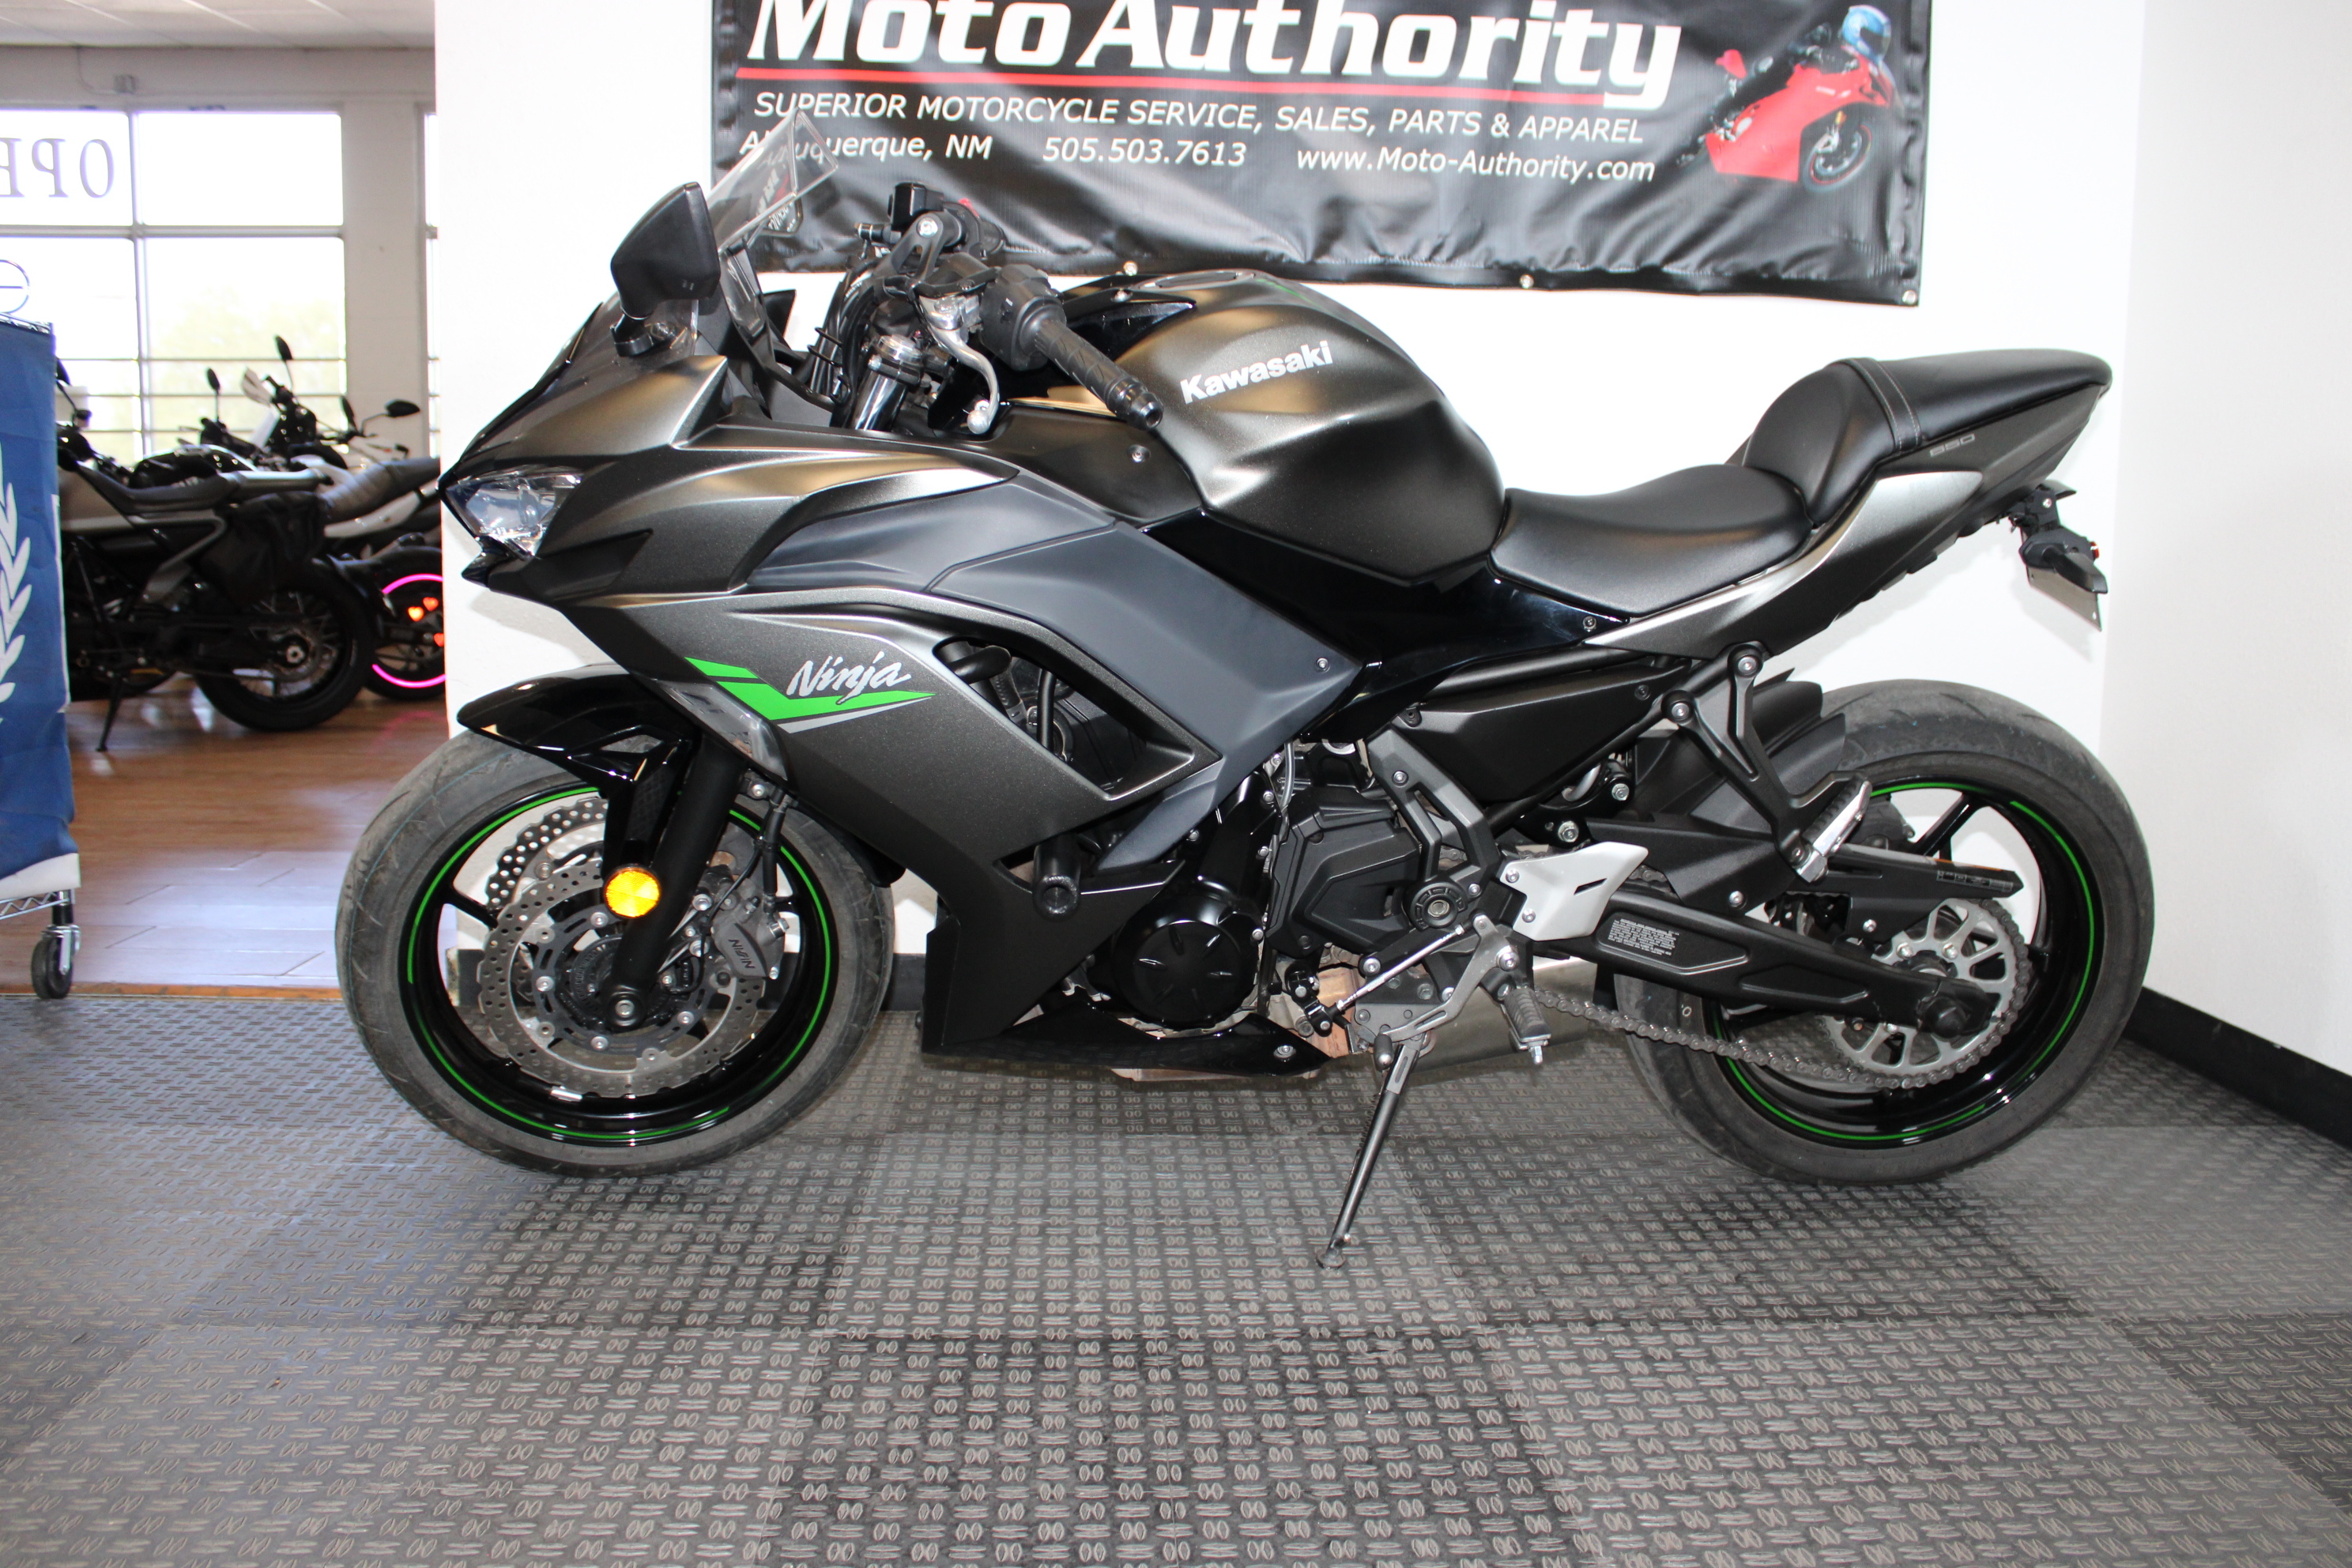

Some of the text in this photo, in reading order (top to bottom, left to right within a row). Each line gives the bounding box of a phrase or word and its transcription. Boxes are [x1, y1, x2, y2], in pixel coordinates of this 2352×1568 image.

[747, 0, 1682, 111] Moto Authority
[754, 91, 1643, 143] SUPERIOR MOTORCYCLE SERVICE, SALES, PARTS & APPAREL
[739, 130, 1656, 183] Auquerque, NM 505.503.7613 www.Moto-Authority.com
[1180, 340, 1333, 405] Kawasaki
[786, 650, 912, 705] Ninja
